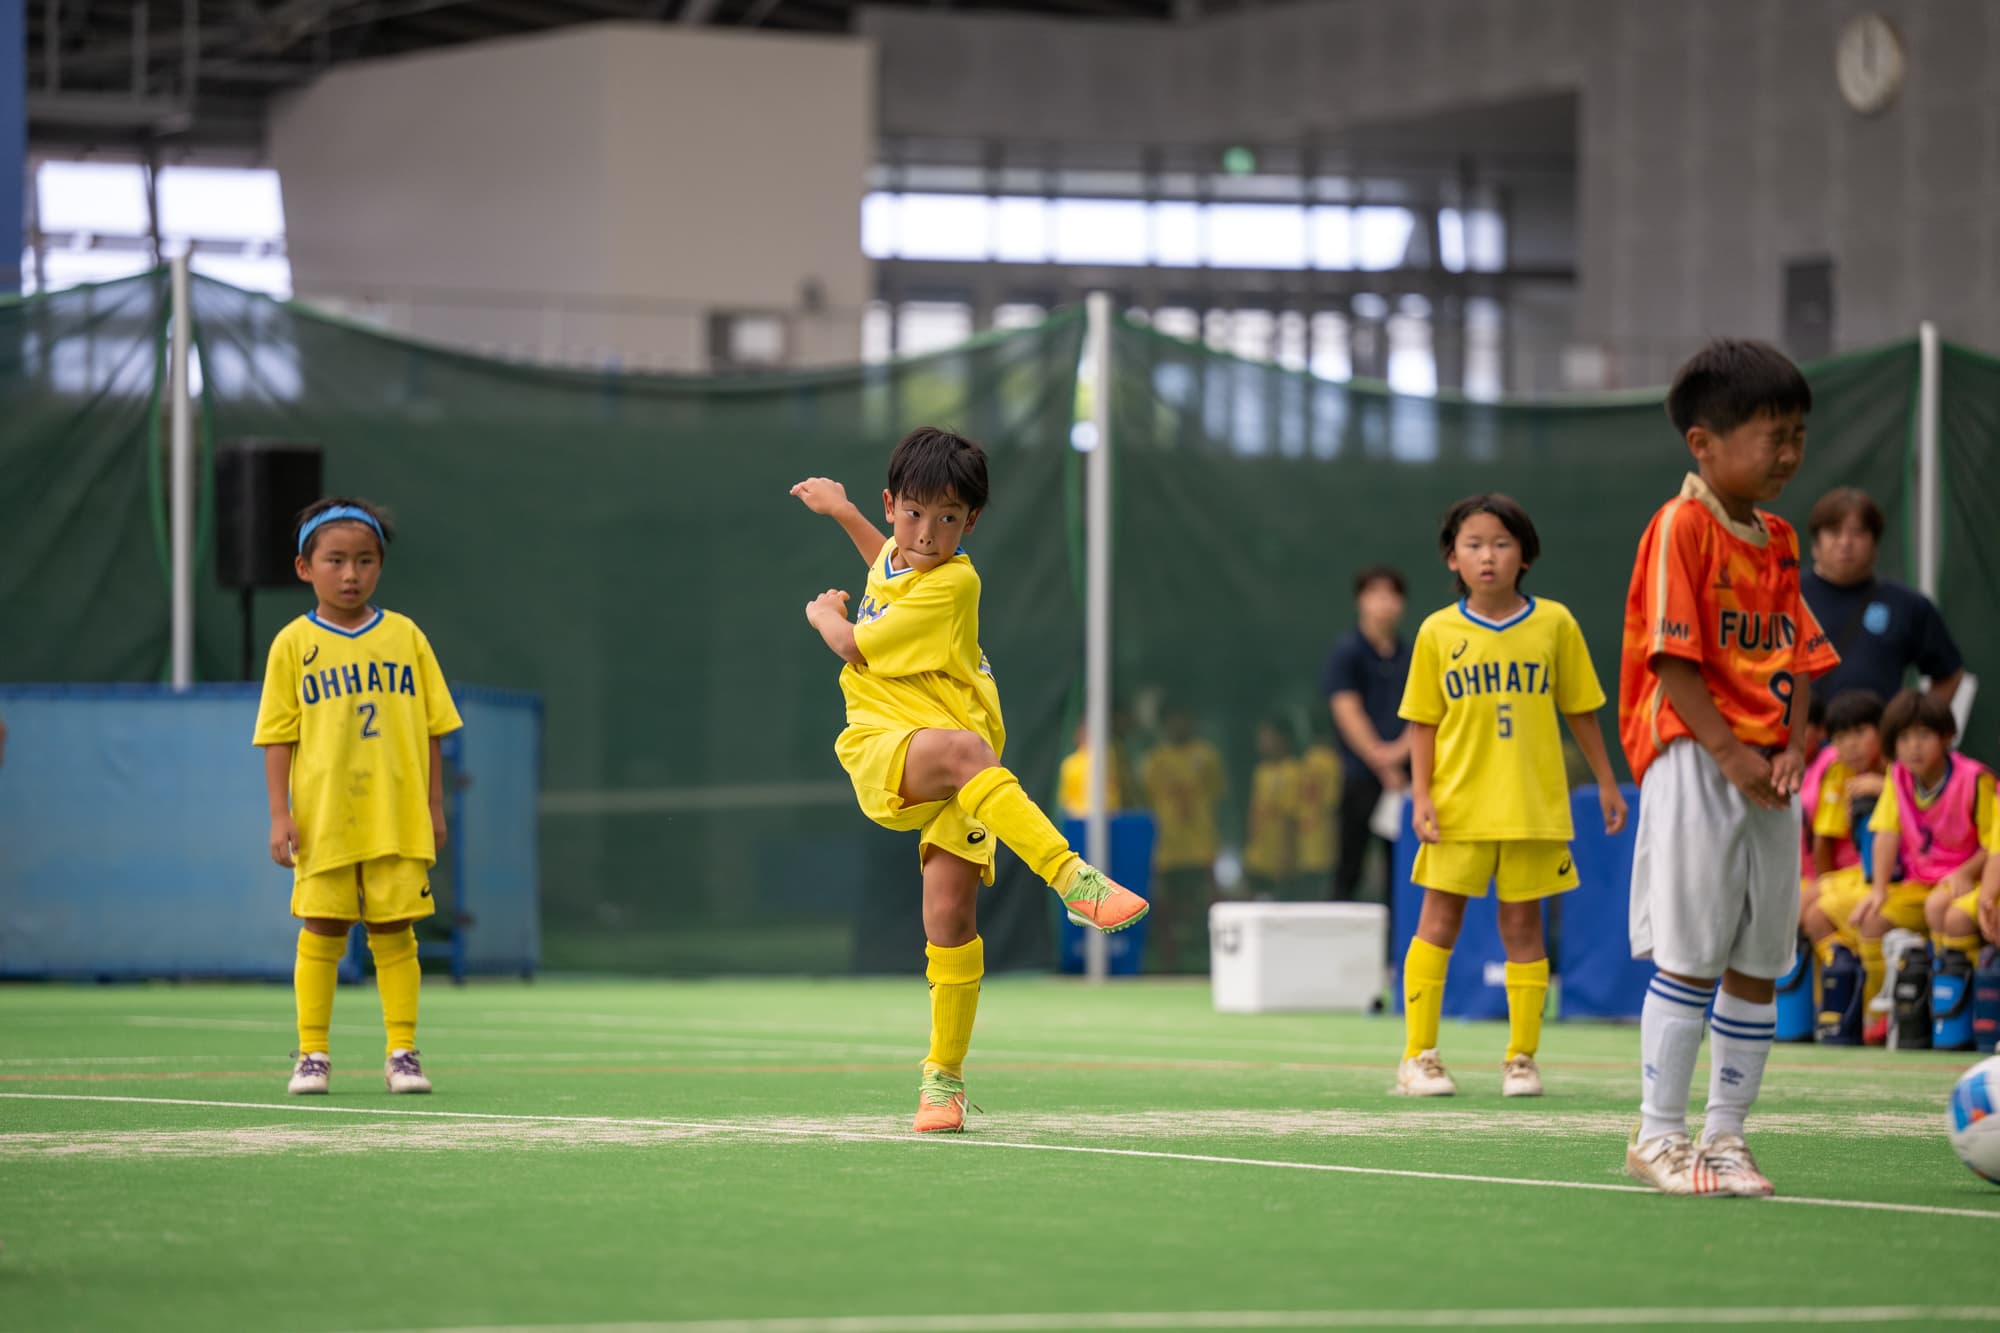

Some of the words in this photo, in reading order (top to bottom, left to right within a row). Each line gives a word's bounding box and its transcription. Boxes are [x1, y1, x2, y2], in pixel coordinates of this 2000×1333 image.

[302, 661, 416, 705] OHHATA
[1768, 671, 1794, 727] 9
[357, 702, 380, 739] 2
[1497, 702, 1513, 739] 5
